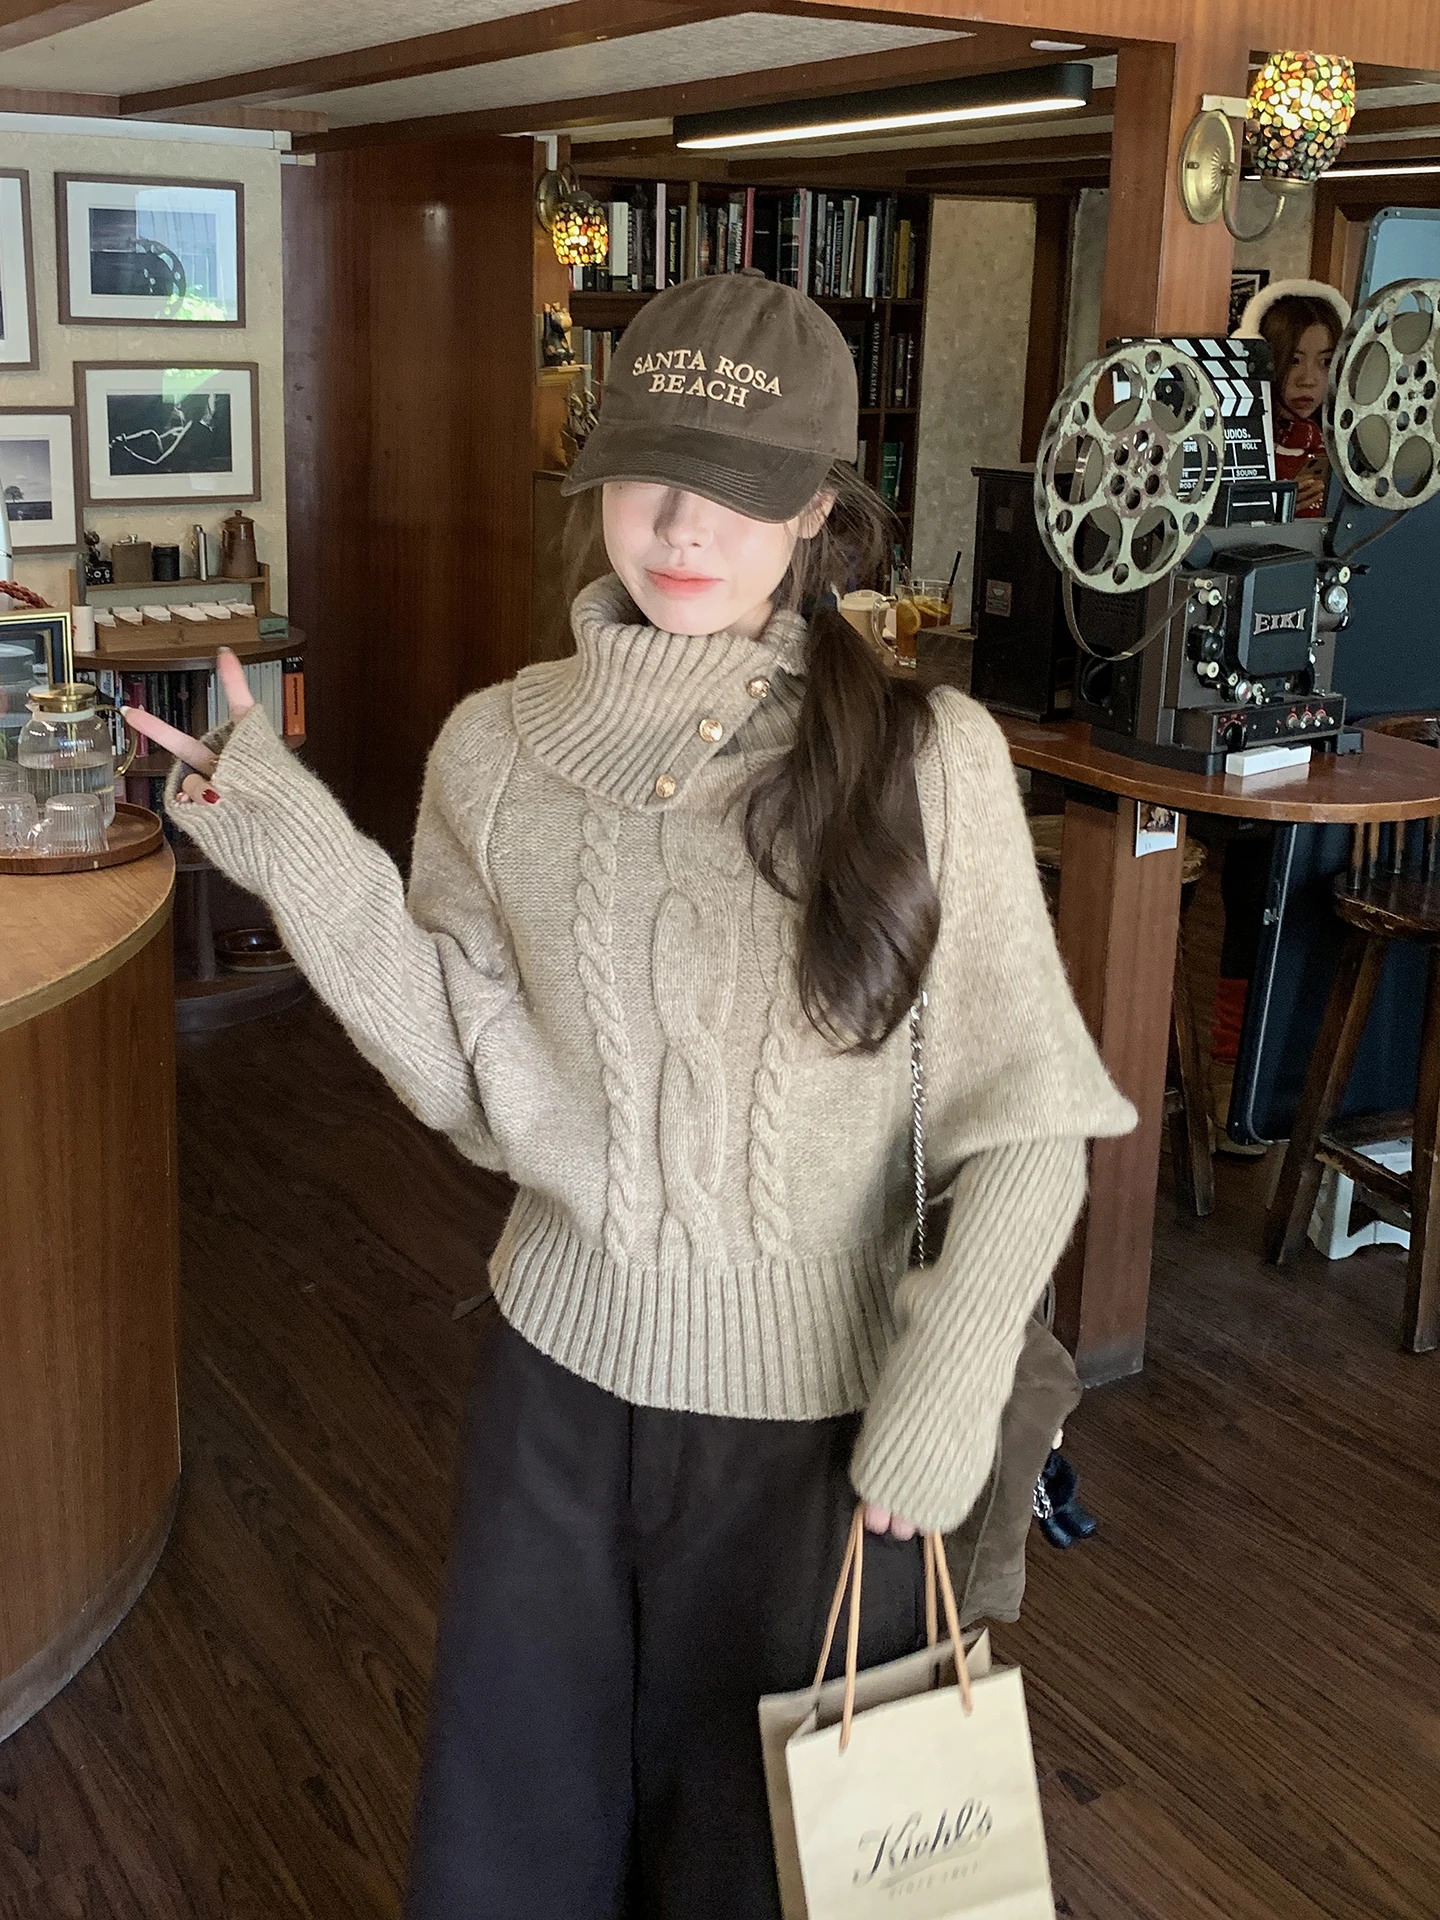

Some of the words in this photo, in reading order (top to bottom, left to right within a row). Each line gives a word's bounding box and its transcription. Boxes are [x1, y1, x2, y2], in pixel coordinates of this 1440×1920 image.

[872, 321, 880, 352] DAVID
[632, 349, 707, 376] SANTA
[714, 355, 782, 397] ROSA
[648, 373, 749, 408] BEACH
[1224, 428, 1251, 440] UDIOS.
[1241, 442, 1258, 450] ROLL
[1235, 469, 1258, 477] SOUND
[1253, 608, 1307, 635] EIKI
[852, 1797, 993, 1887] Kiehl's
